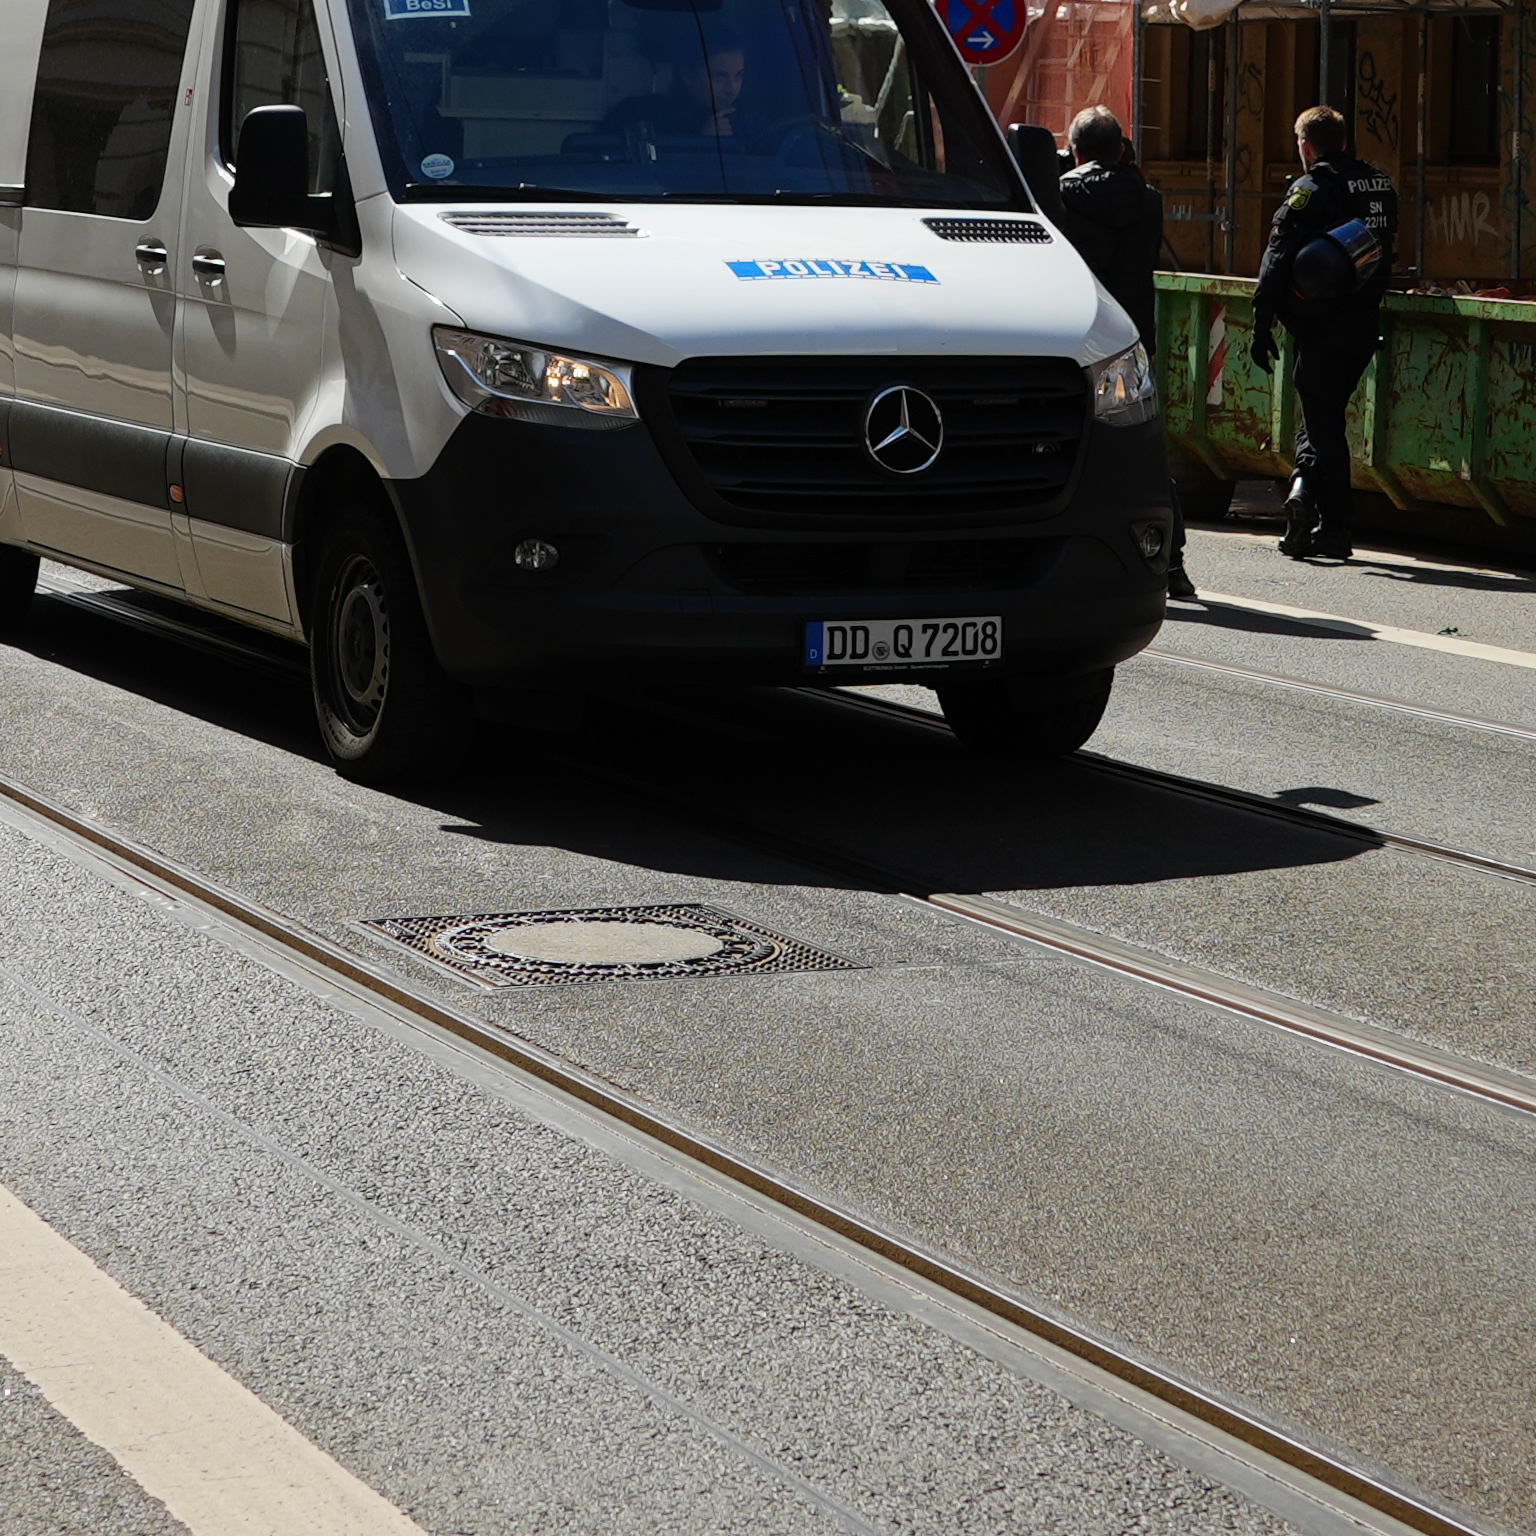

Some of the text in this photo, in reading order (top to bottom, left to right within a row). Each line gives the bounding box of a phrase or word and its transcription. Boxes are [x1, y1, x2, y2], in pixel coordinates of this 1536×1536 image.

[1369, 201, 1383, 214] SN
[1364, 215, 1388, 229] 22/11
[756, 261, 909, 279] POLIZEI
[826, 620, 998, 660] DD Q 7208
[809, 649, 818, 659] D
